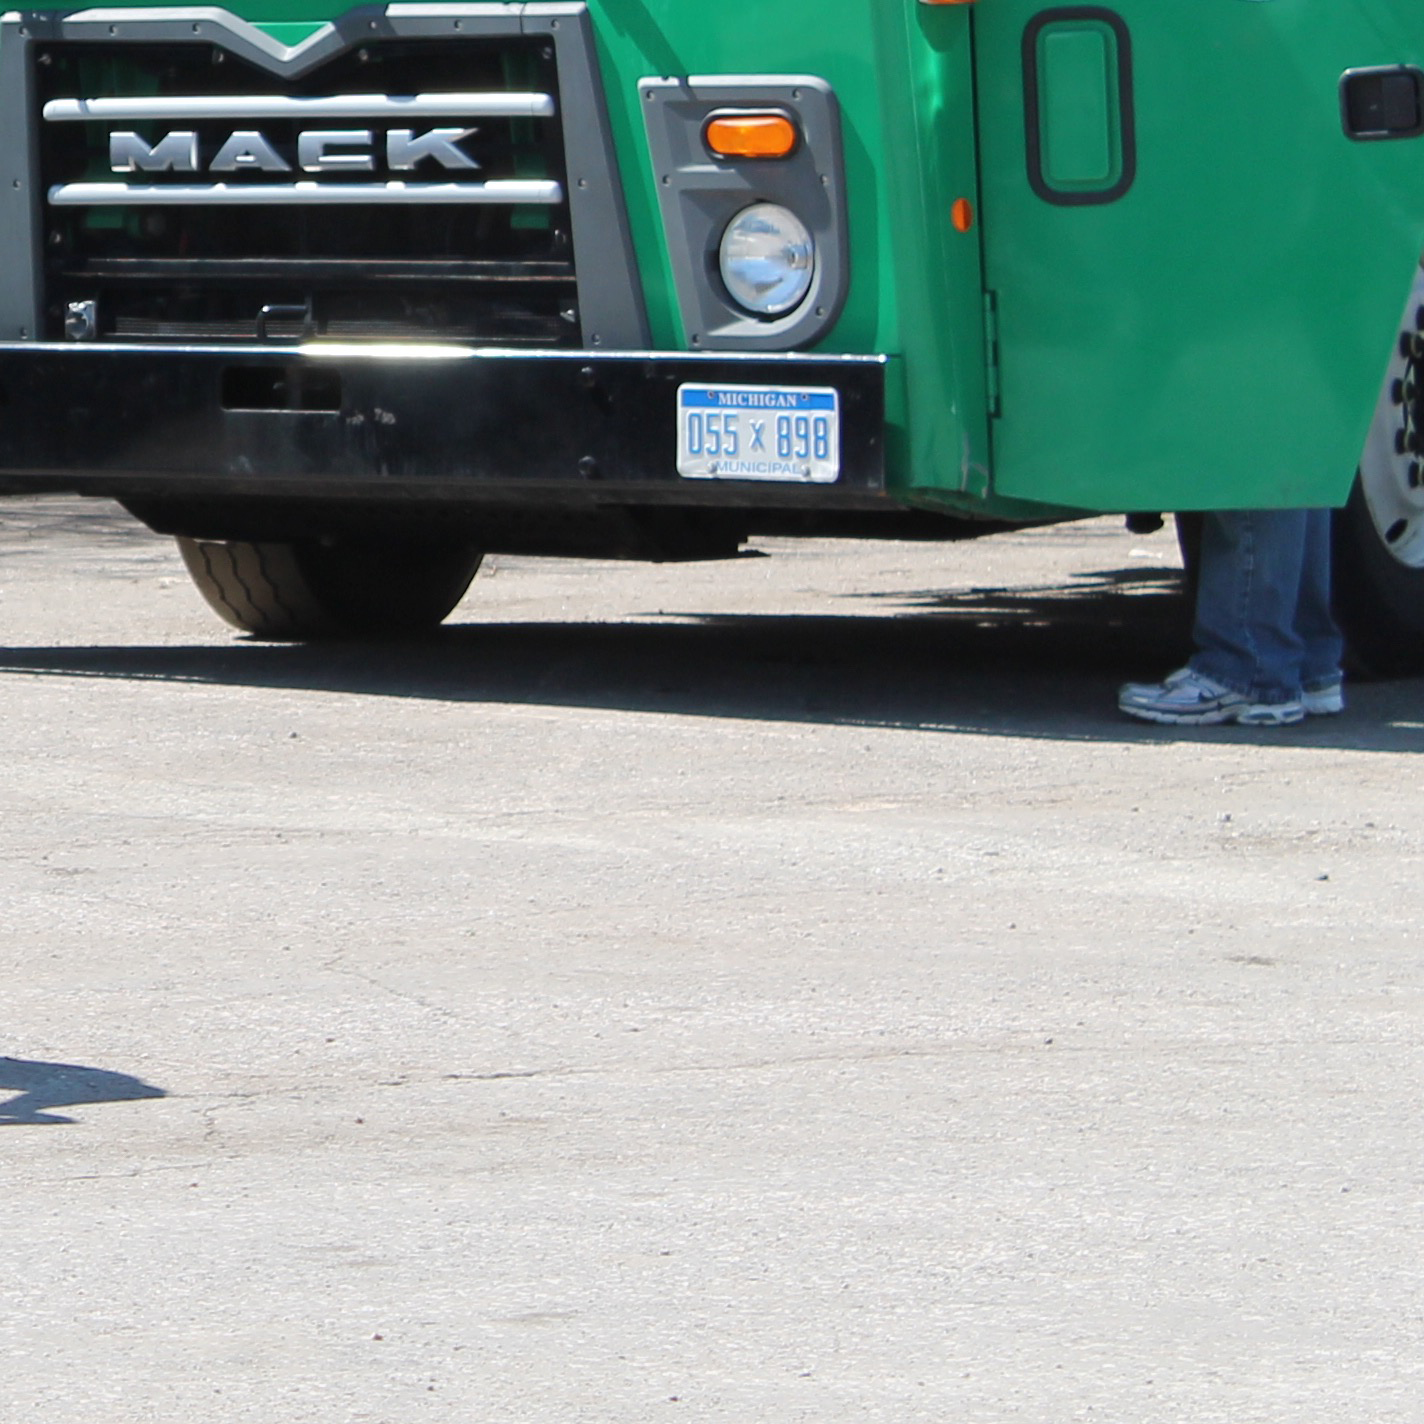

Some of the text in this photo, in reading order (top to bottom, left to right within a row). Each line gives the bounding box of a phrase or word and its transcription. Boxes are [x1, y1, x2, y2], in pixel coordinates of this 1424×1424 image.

[109, 127, 482, 173] MACK
[717, 392, 798, 408] MICHIGAN
[687, 412, 829, 460] 055 X 898
[715, 461, 803, 475] MUNICIPAL
